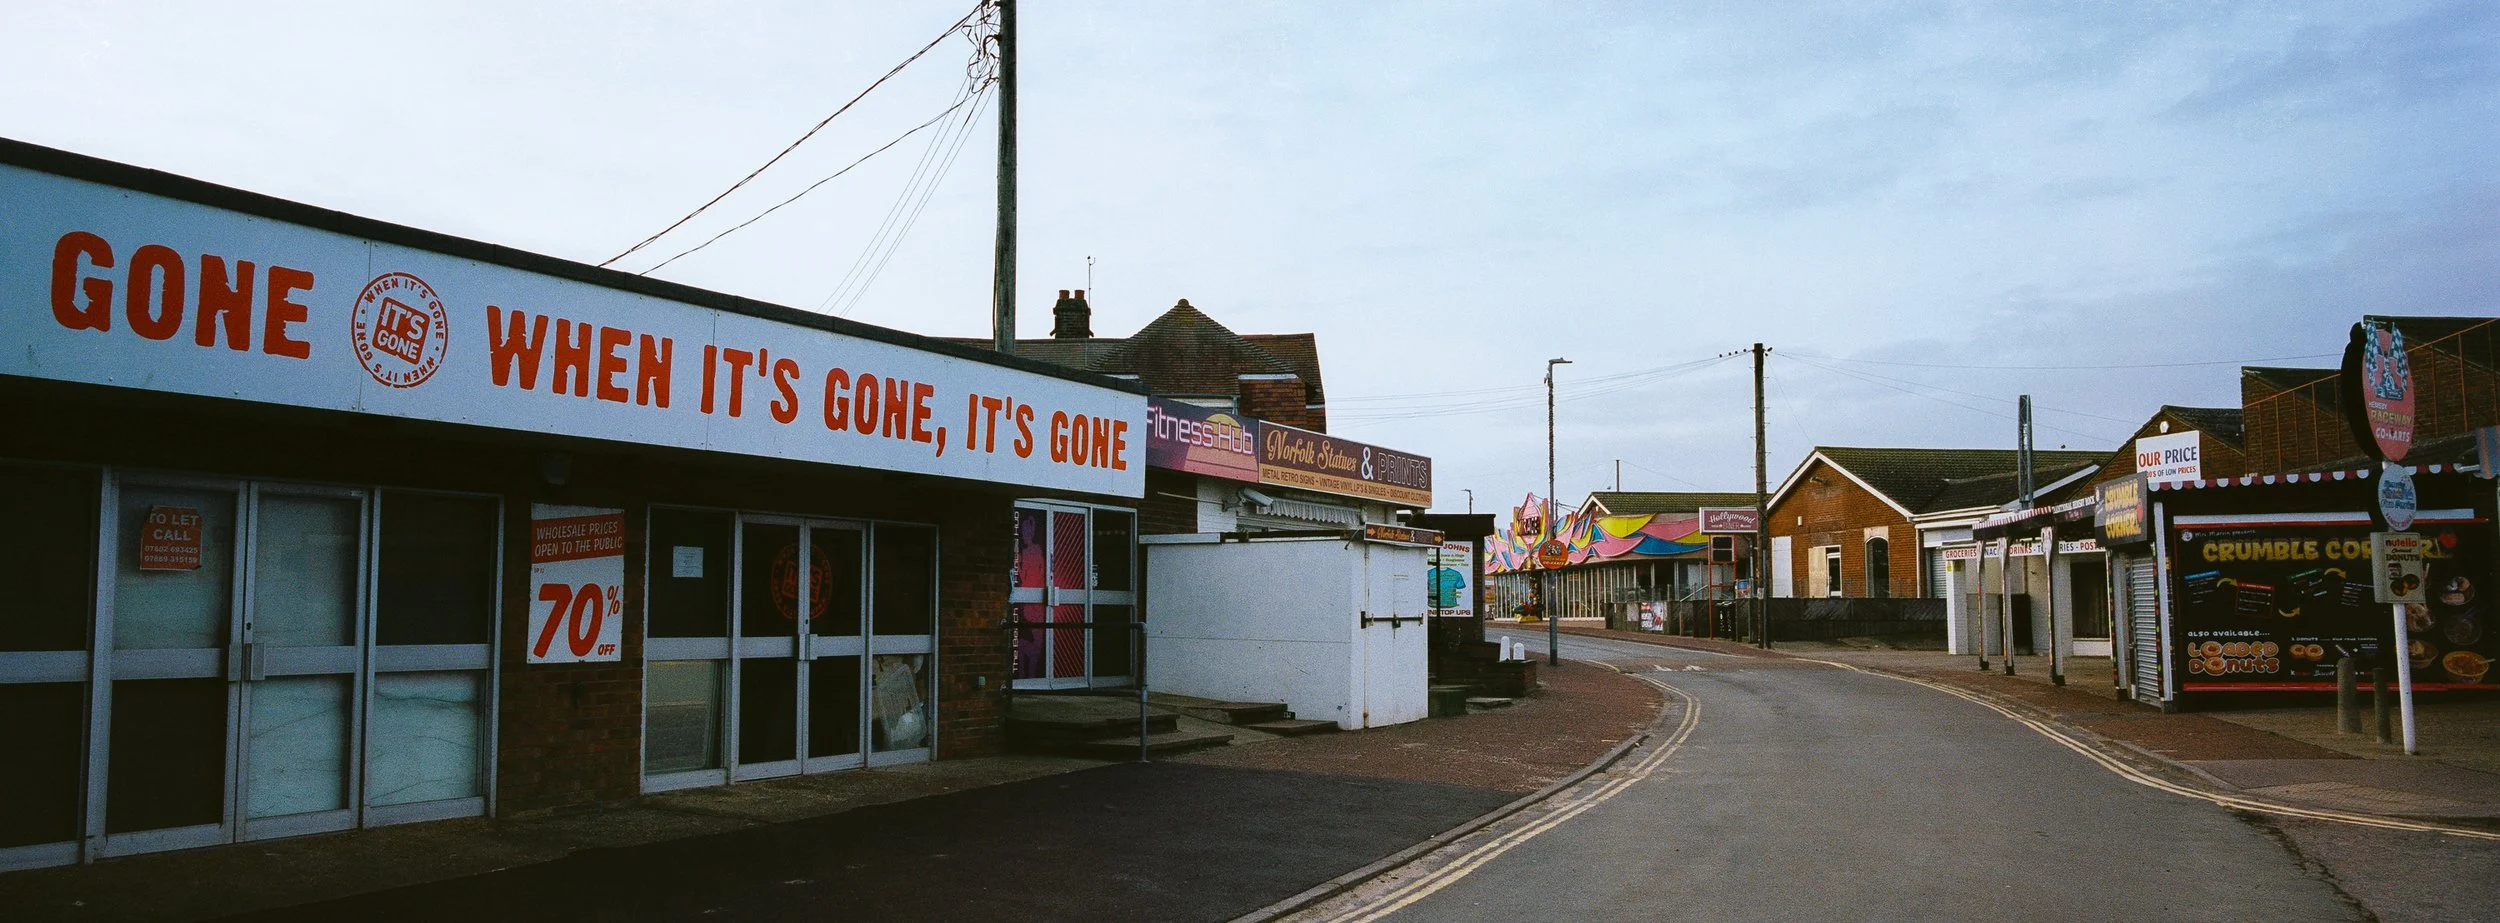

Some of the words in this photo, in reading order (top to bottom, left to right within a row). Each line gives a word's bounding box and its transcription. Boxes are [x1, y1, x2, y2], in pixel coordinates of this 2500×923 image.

[51, 231, 314, 359] GONE
[364, 278, 399, 304] WHEN
[404, 279, 428, 299] IT'S
[428, 301, 445, 340] GONE
[381, 301, 425, 340] IT'S
[356, 322, 373, 361] GONE
[377, 329, 420, 360] GONE
[373, 363, 398, 382] IT'S
[403, 357, 435, 383] WHEN
[486, 305, 673, 408] WHEN
[700, 345, 800, 425] IT'S
[824, 368, 947, 457] GONE,
[966, 394, 1034, 459] IT'S
[1051, 410, 1128, 471] GONE
[2370, 410, 2412, 426] RACEWAY
[1147, 406, 1214, 448] Fitness
[1218, 421, 1253, 455] Hub
[2376, 427, 2410, 442] GO-KARTS
[1266, 429, 1315, 465] Norfolk
[1317, 440, 1357, 472] Statues
[1361, 446, 1374, 480] &
[1378, 453, 1428, 489] PRINTS
[2138, 451, 2161, 468] OUR
[2165, 446, 2197, 464] PRICE
[1262, 468, 1280, 480] METAL
[1281, 471, 1299, 483] RETRO
[1299, 474, 1315, 485] SIGNS
[1319, 477, 1340, 489] VINTAGE
[2157, 469, 2165, 477] OF
[2165, 468, 2177, 476] LOW
[2177, 465, 2197, 475] PRICES
[172, 514, 200, 526] LET
[1708, 511, 1755, 525] Hollywood
[153, 529, 192, 541] CALL
[536, 524, 586, 541] WHOLESALE
[589, 521, 618, 536] PRICES
[535, 543, 559, 557] OPEN
[561, 542, 573, 554] TO
[575, 539, 591, 552] THE
[594, 536, 623, 551] PUBLIC
[1443, 543, 1470, 553] JOHNS
[1945, 549, 1977, 559] GROCERIES
[2010, 545, 2033, 556] DRINKS
[2202, 539, 2320, 562] CRUMBLE
[2385, 537, 2418, 547] nutella
[2385, 554, 2420, 562] DONUTS
[598, 644, 616, 655] OFF
